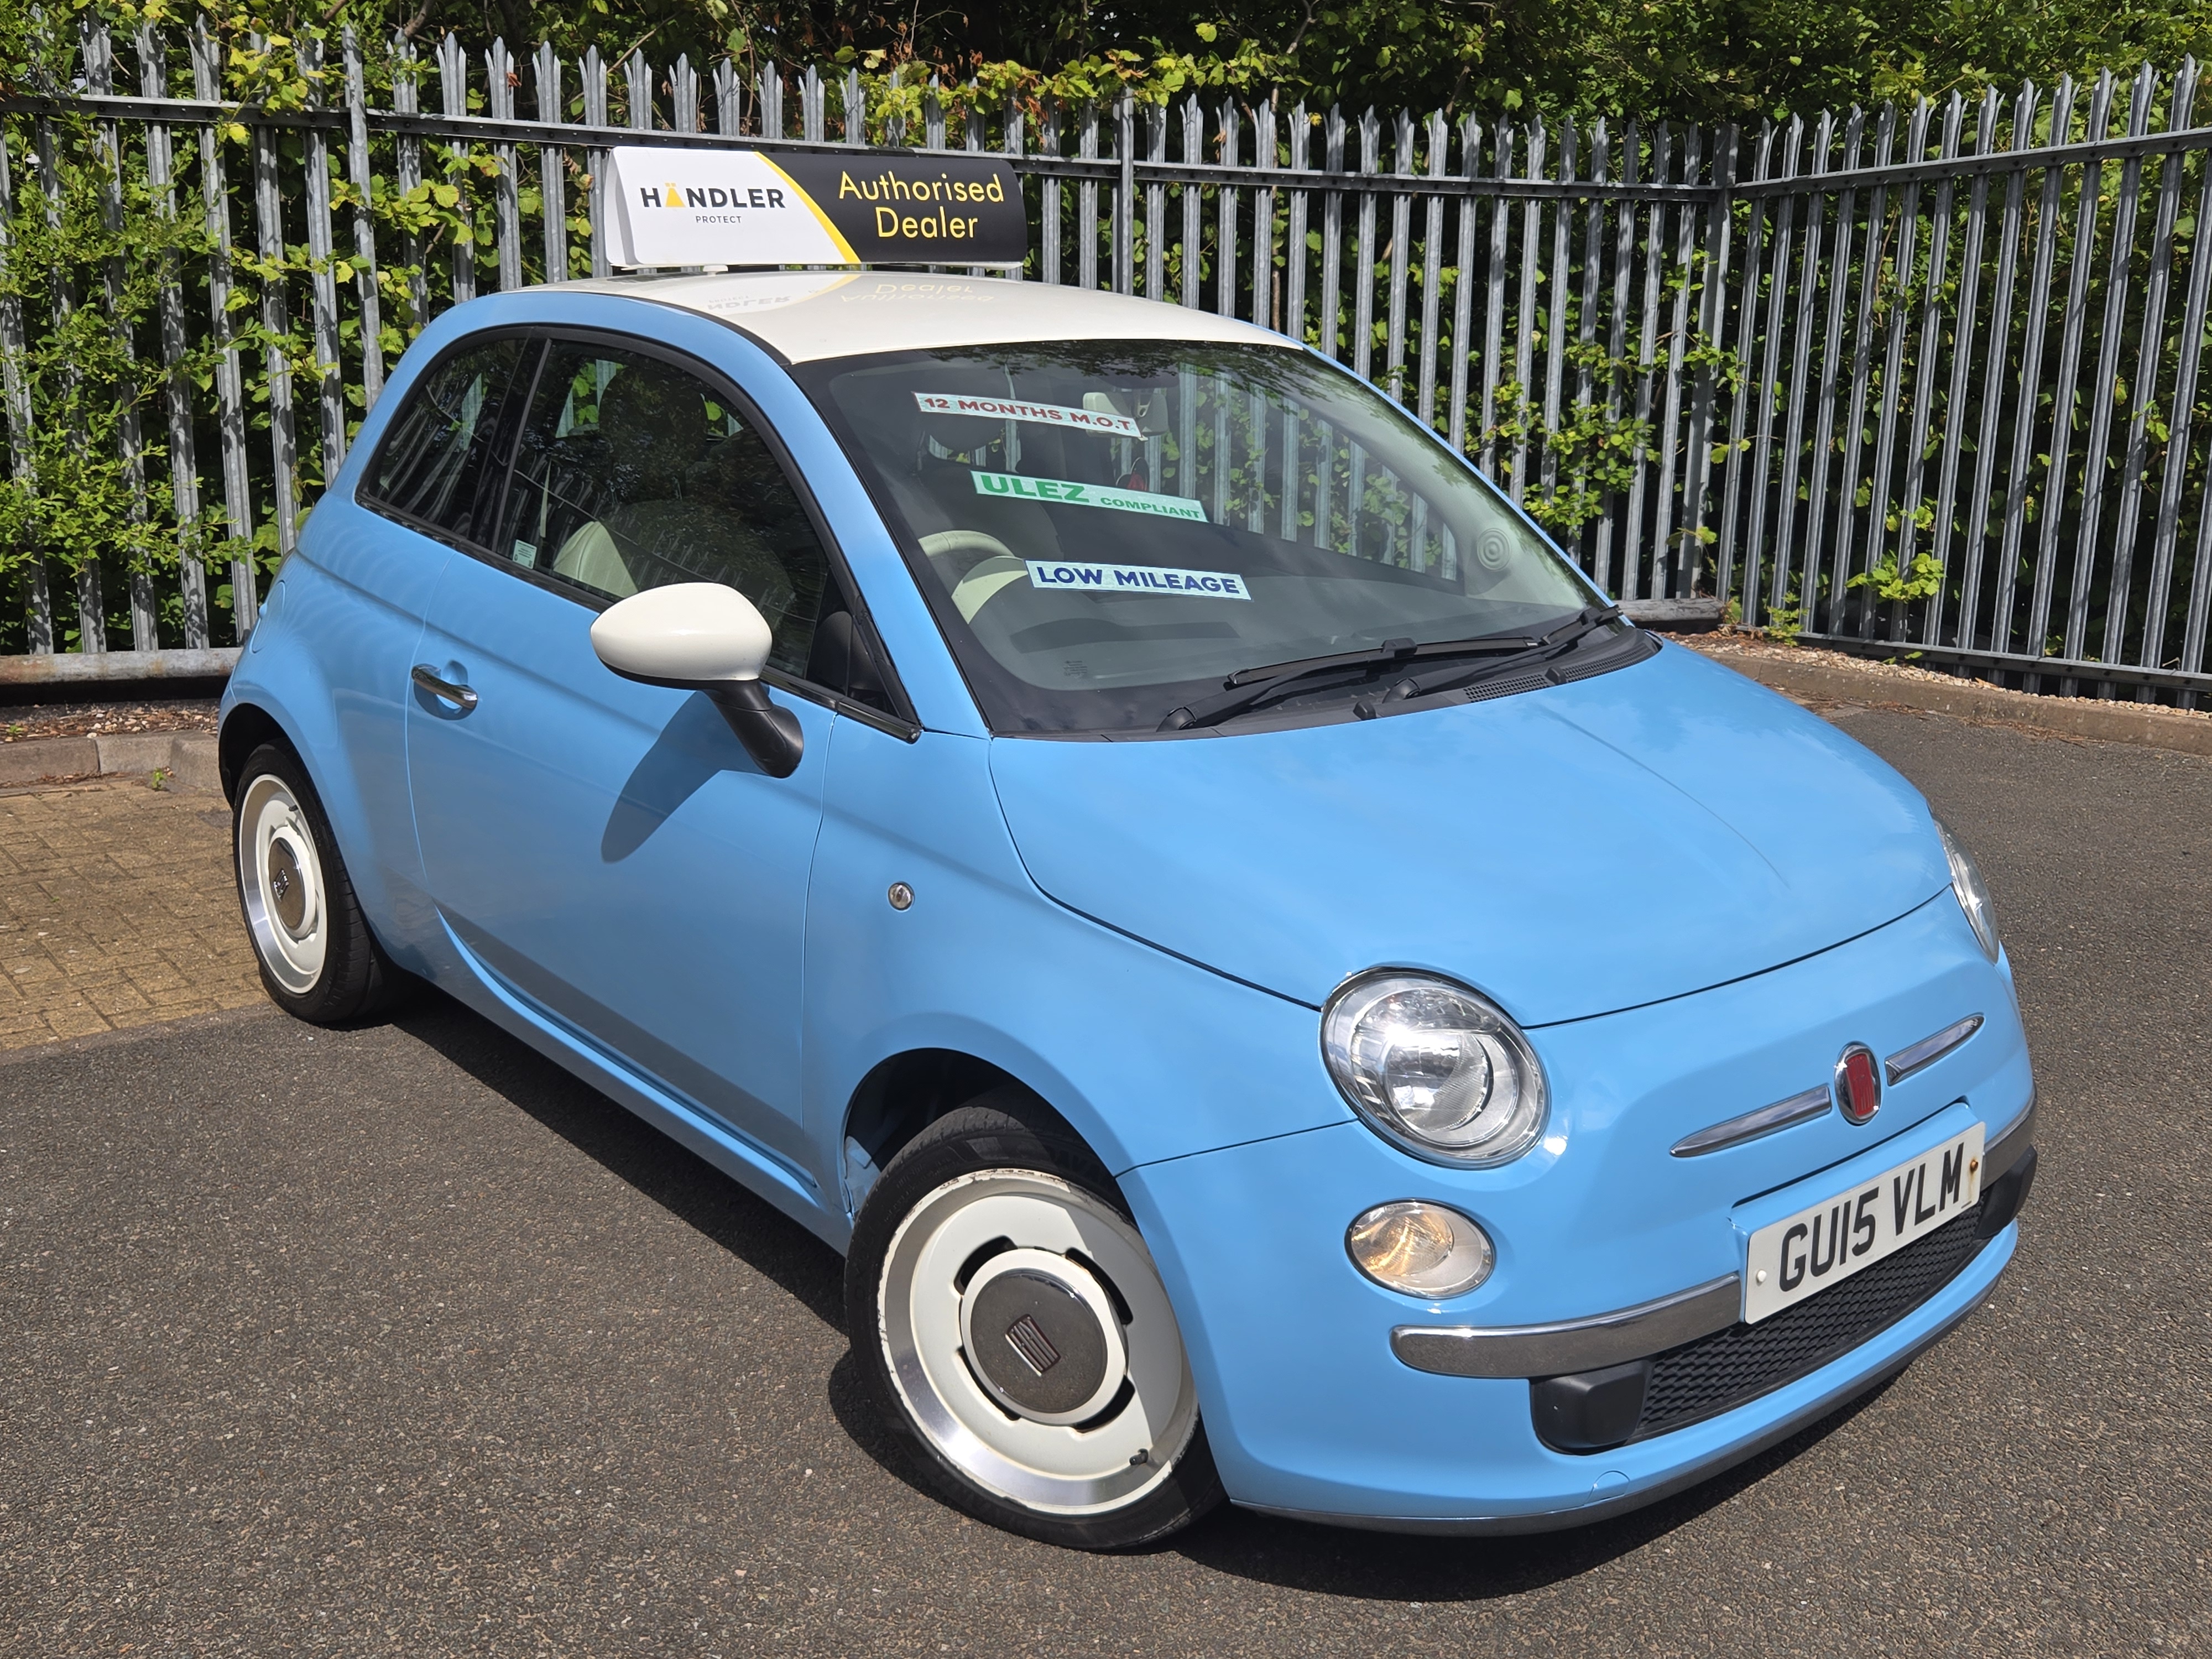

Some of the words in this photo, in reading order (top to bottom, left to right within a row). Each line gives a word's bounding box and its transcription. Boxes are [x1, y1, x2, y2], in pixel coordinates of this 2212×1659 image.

[839, 170, 1004, 202] Authorised
[695, 215, 742, 223] PROTECT
[875, 206, 978, 238] Dealer
[925, 398, 950, 409] 12
[958, 400, 1062, 420] MONTHS
[1071, 413, 1131, 431] M.O.T
[981, 475, 1089, 502] ULEZ
[1100, 498, 1200, 519] COMPLIANT
[1037, 567, 1103, 585] LOW
[1114, 571, 1240, 593] MILEAGE
[1780, 1186, 1879, 1292] GU15
[1893, 1142, 1964, 1237] VLM
